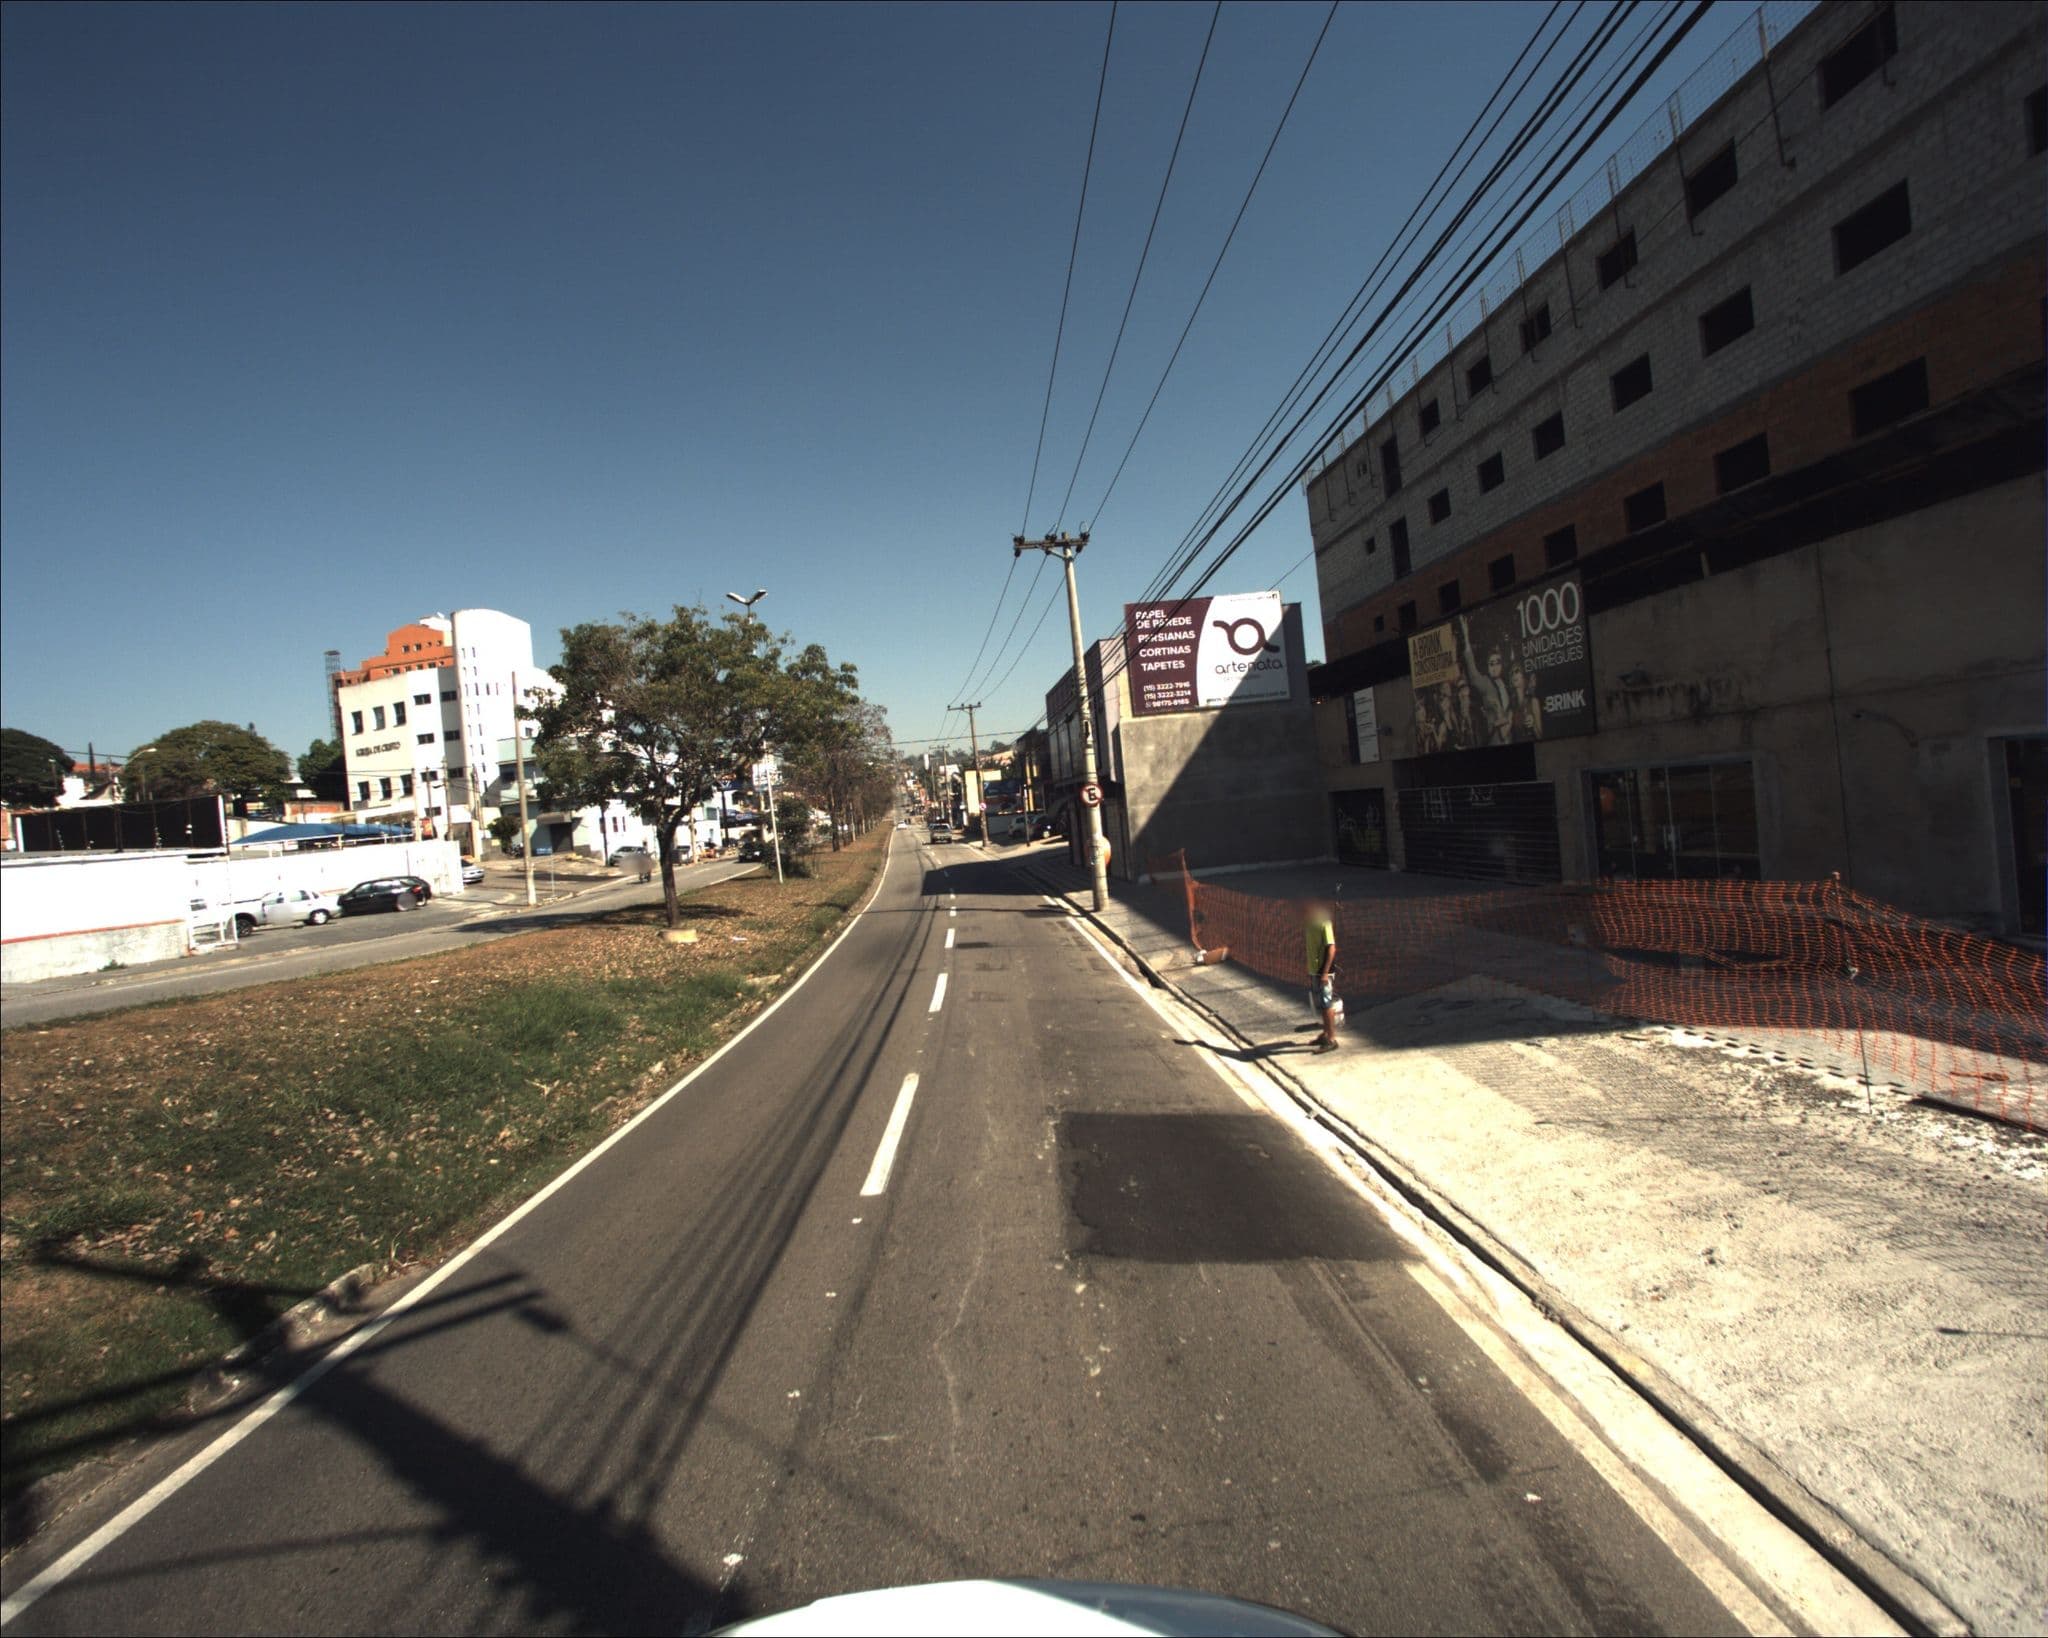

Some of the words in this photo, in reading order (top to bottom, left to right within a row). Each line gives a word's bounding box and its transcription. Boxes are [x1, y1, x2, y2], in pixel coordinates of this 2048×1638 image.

[1517, 582, 1579, 638] 1000
[1139, 645, 1191, 657] CORTINAS
[1522, 625, 1583, 658] UNIDADES
[1141, 660, 1185, 671] TAPETES
[1524, 645, 1583, 672] ENTREGUES
[1545, 690, 1586, 712] BRINK
